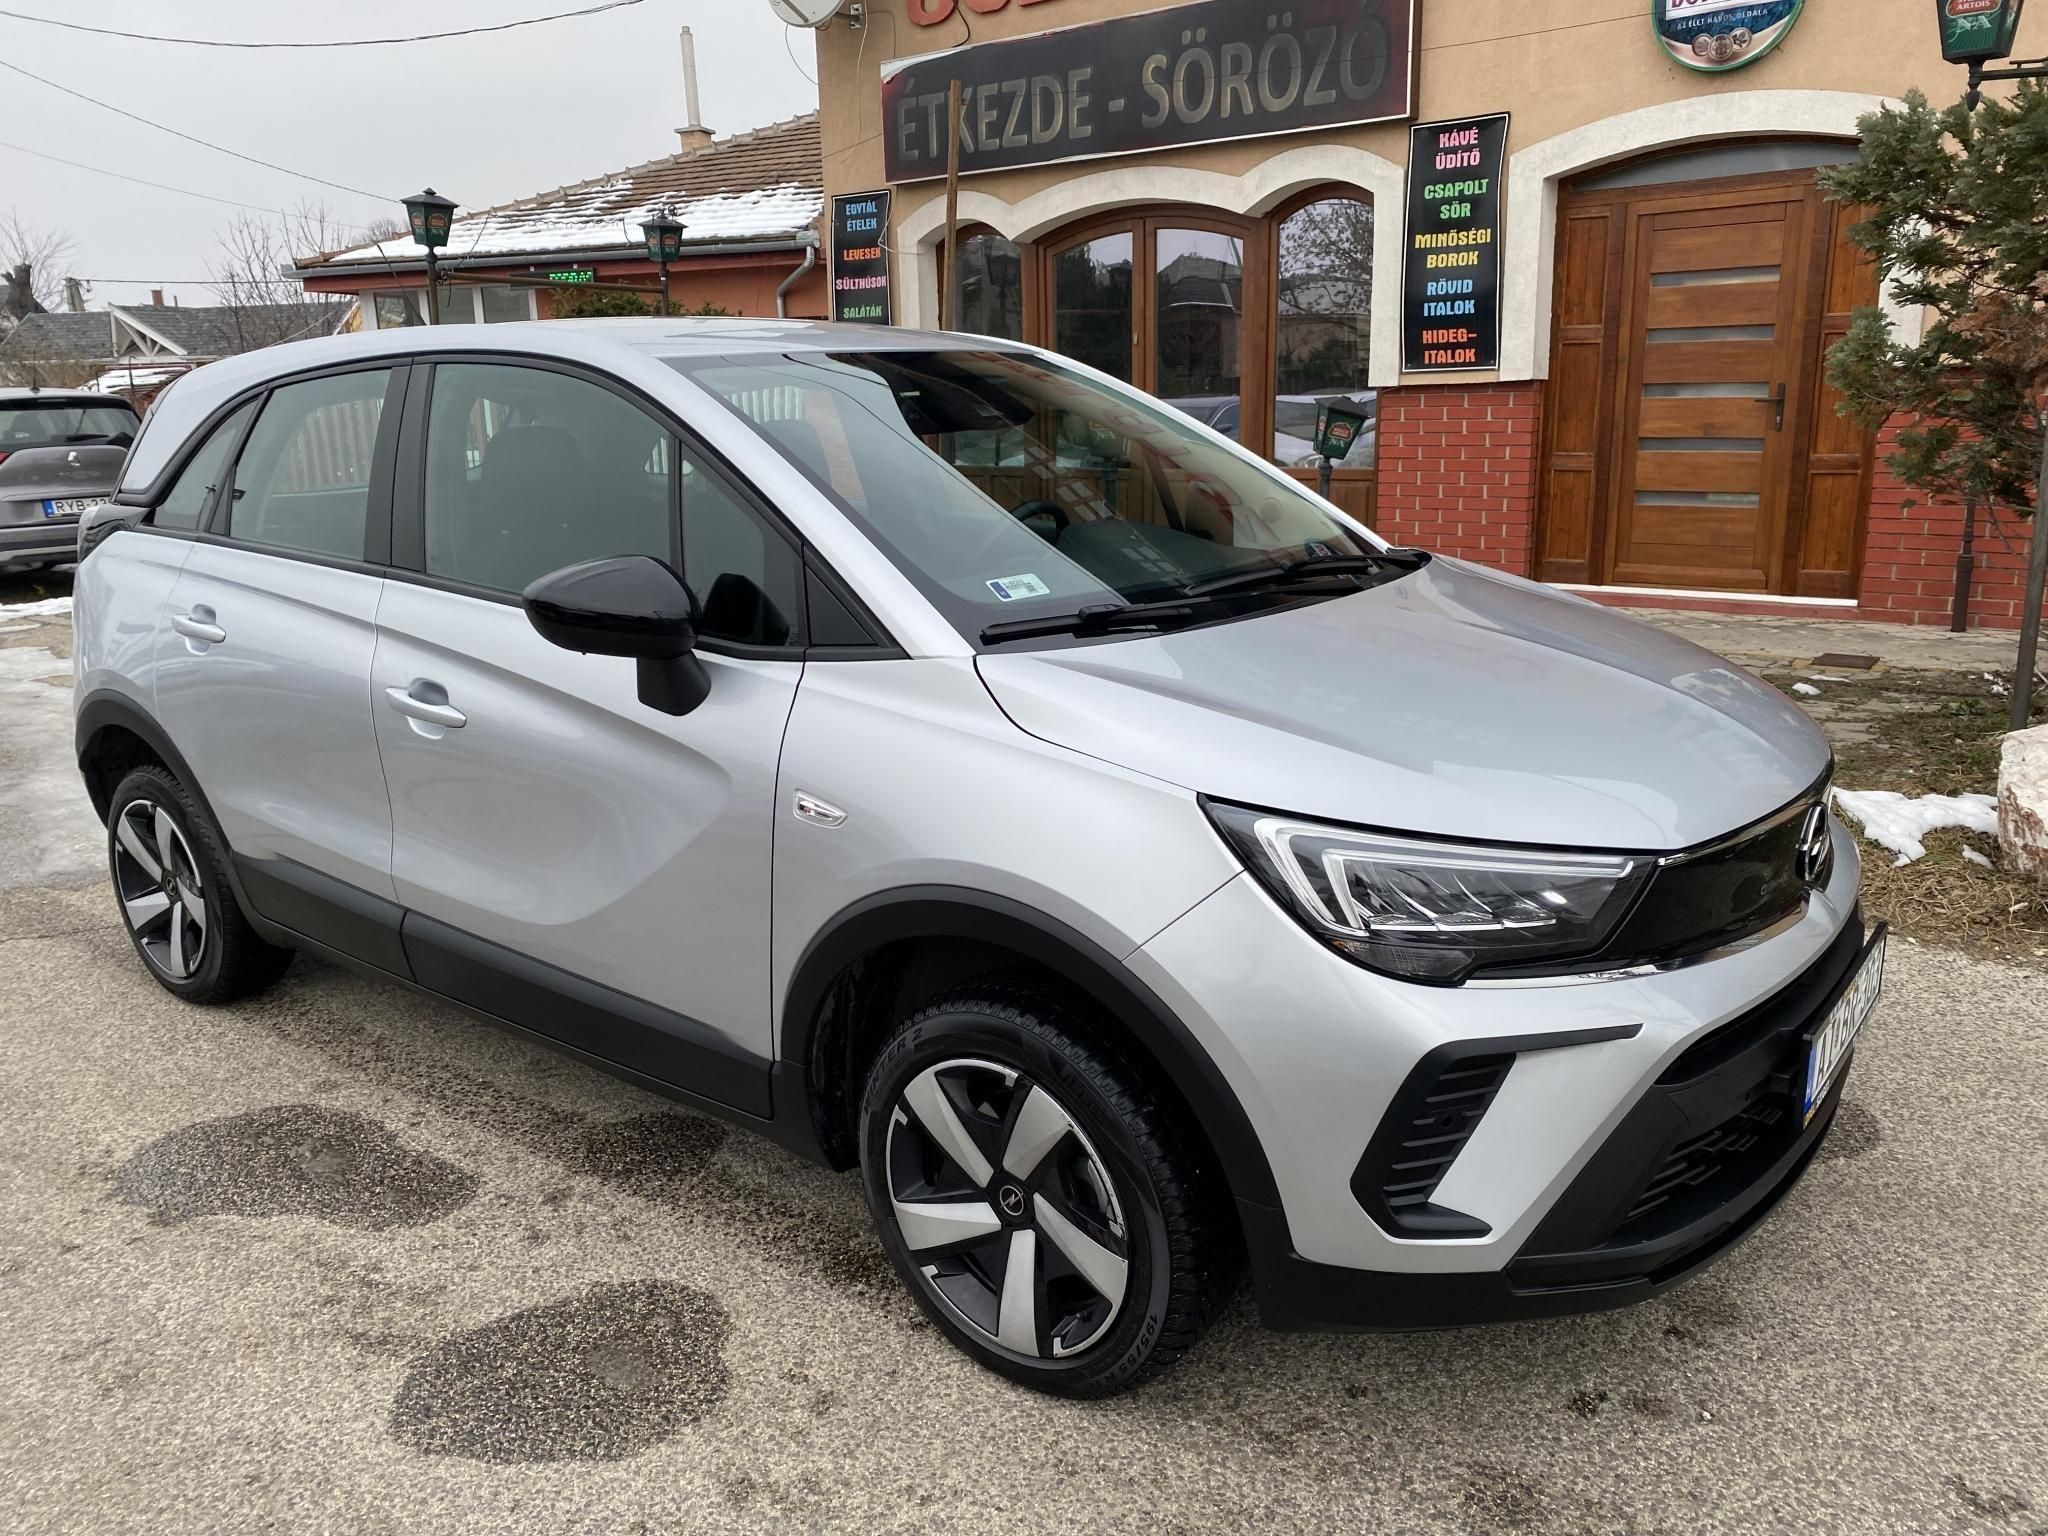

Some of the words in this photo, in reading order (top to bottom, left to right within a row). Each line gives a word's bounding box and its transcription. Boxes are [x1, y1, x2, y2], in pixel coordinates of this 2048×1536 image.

[1736, 8, 1768, 19] OLDALA
[1956, 1, 1991, 11] ARTOIS
[897, 78, 1091, 161] ÉTKEZDE
[1439, 127, 1479, 148] KÁVÉ
[1435, 148, 1481, 170] ÜDÍTŐ
[1424, 179, 1489, 200] CSAPOLT
[845, 200, 877, 215] EGYTÁL
[1440, 201, 1471, 219] SÖR
[846, 217, 877, 232] ÉTELEK
[1414, 227, 1491, 249] MINŐSÉGI
[843, 247, 881, 261] LEVESEK
[1426, 251, 1479, 269] BOROK
[835, 275, 887, 290] SÜLTHÚSOK
[1426, 278, 1473, 296] RÖVID
[843, 304, 882, 319] SALÁTÁK
[1423, 300, 1475, 317] ITALOK
[1422, 328, 1477, 344] HIDEG-
[1424, 348, 1476, 364] ITALOK
